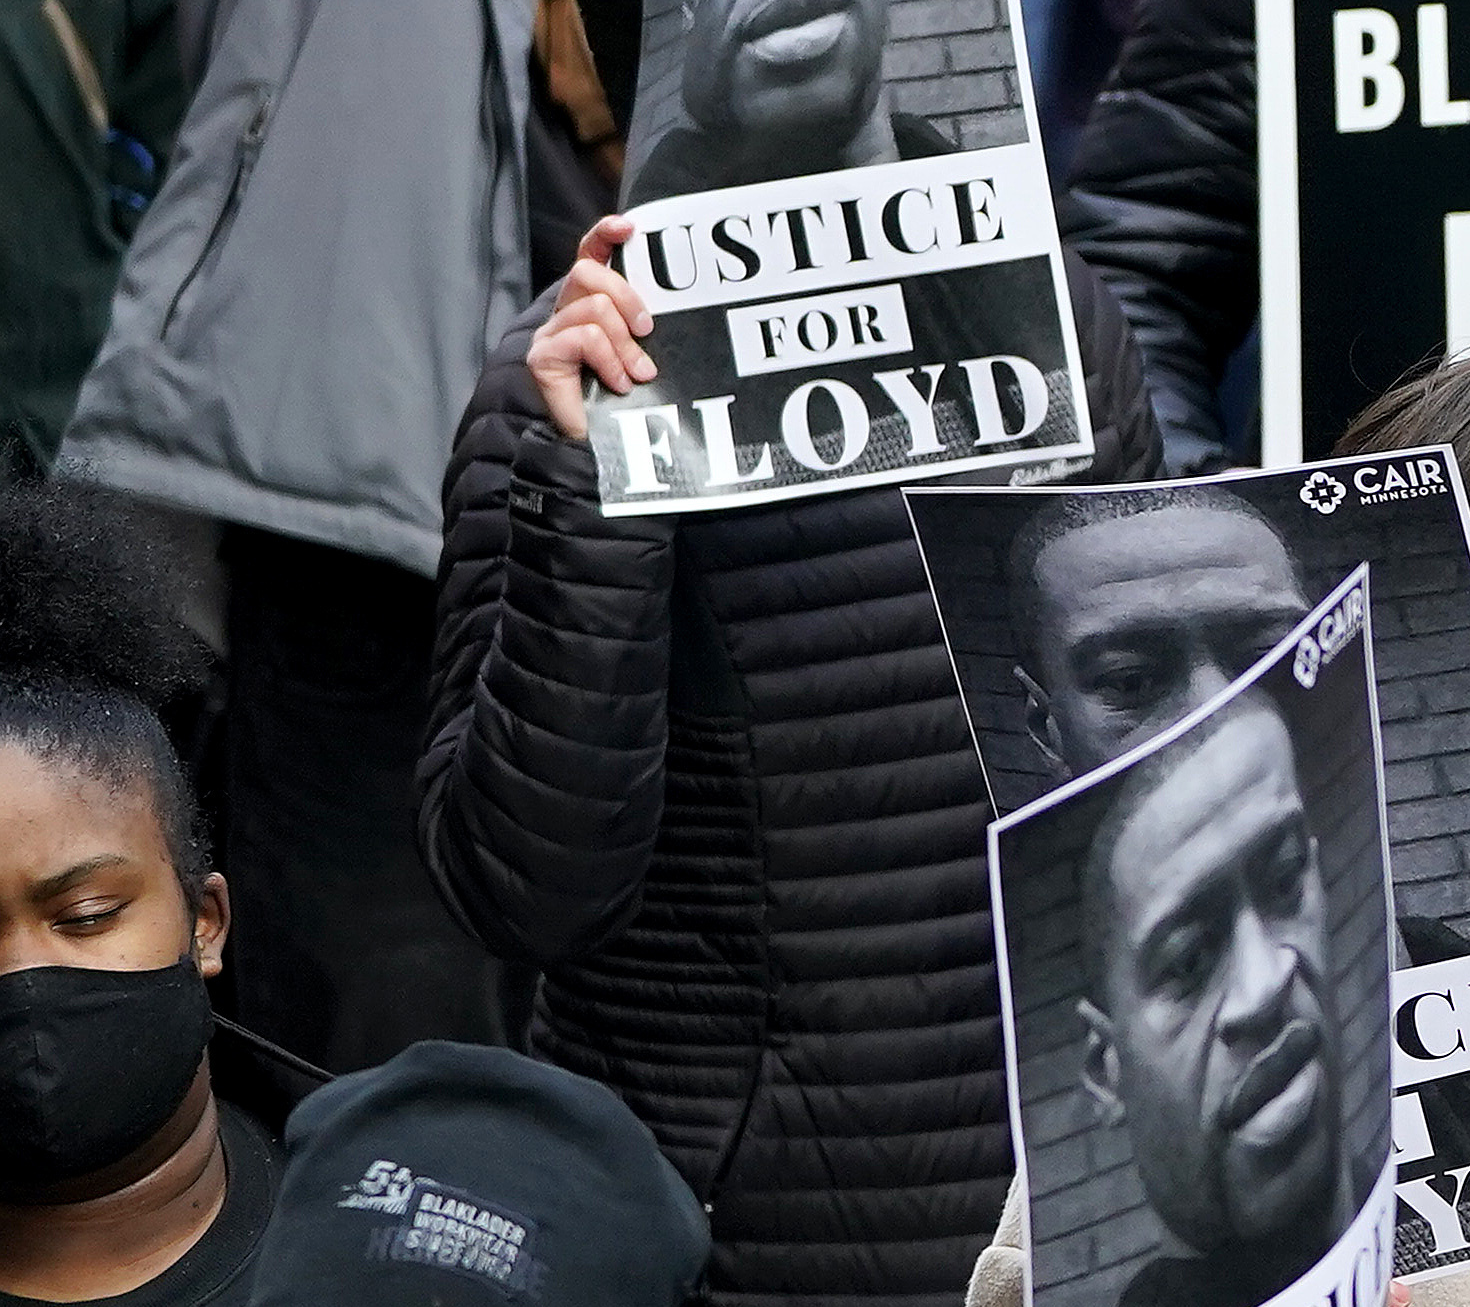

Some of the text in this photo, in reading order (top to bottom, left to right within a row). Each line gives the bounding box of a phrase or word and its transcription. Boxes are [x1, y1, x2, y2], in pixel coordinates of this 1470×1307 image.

[612, 176, 1005, 292] USTICE
[756, 303, 888, 361] FOR
[609, 353, 1051, 495] FLOYD
[1353, 458, 1444, 494] CAIR
[1360, 484, 1448, 506] MINNESOTA
